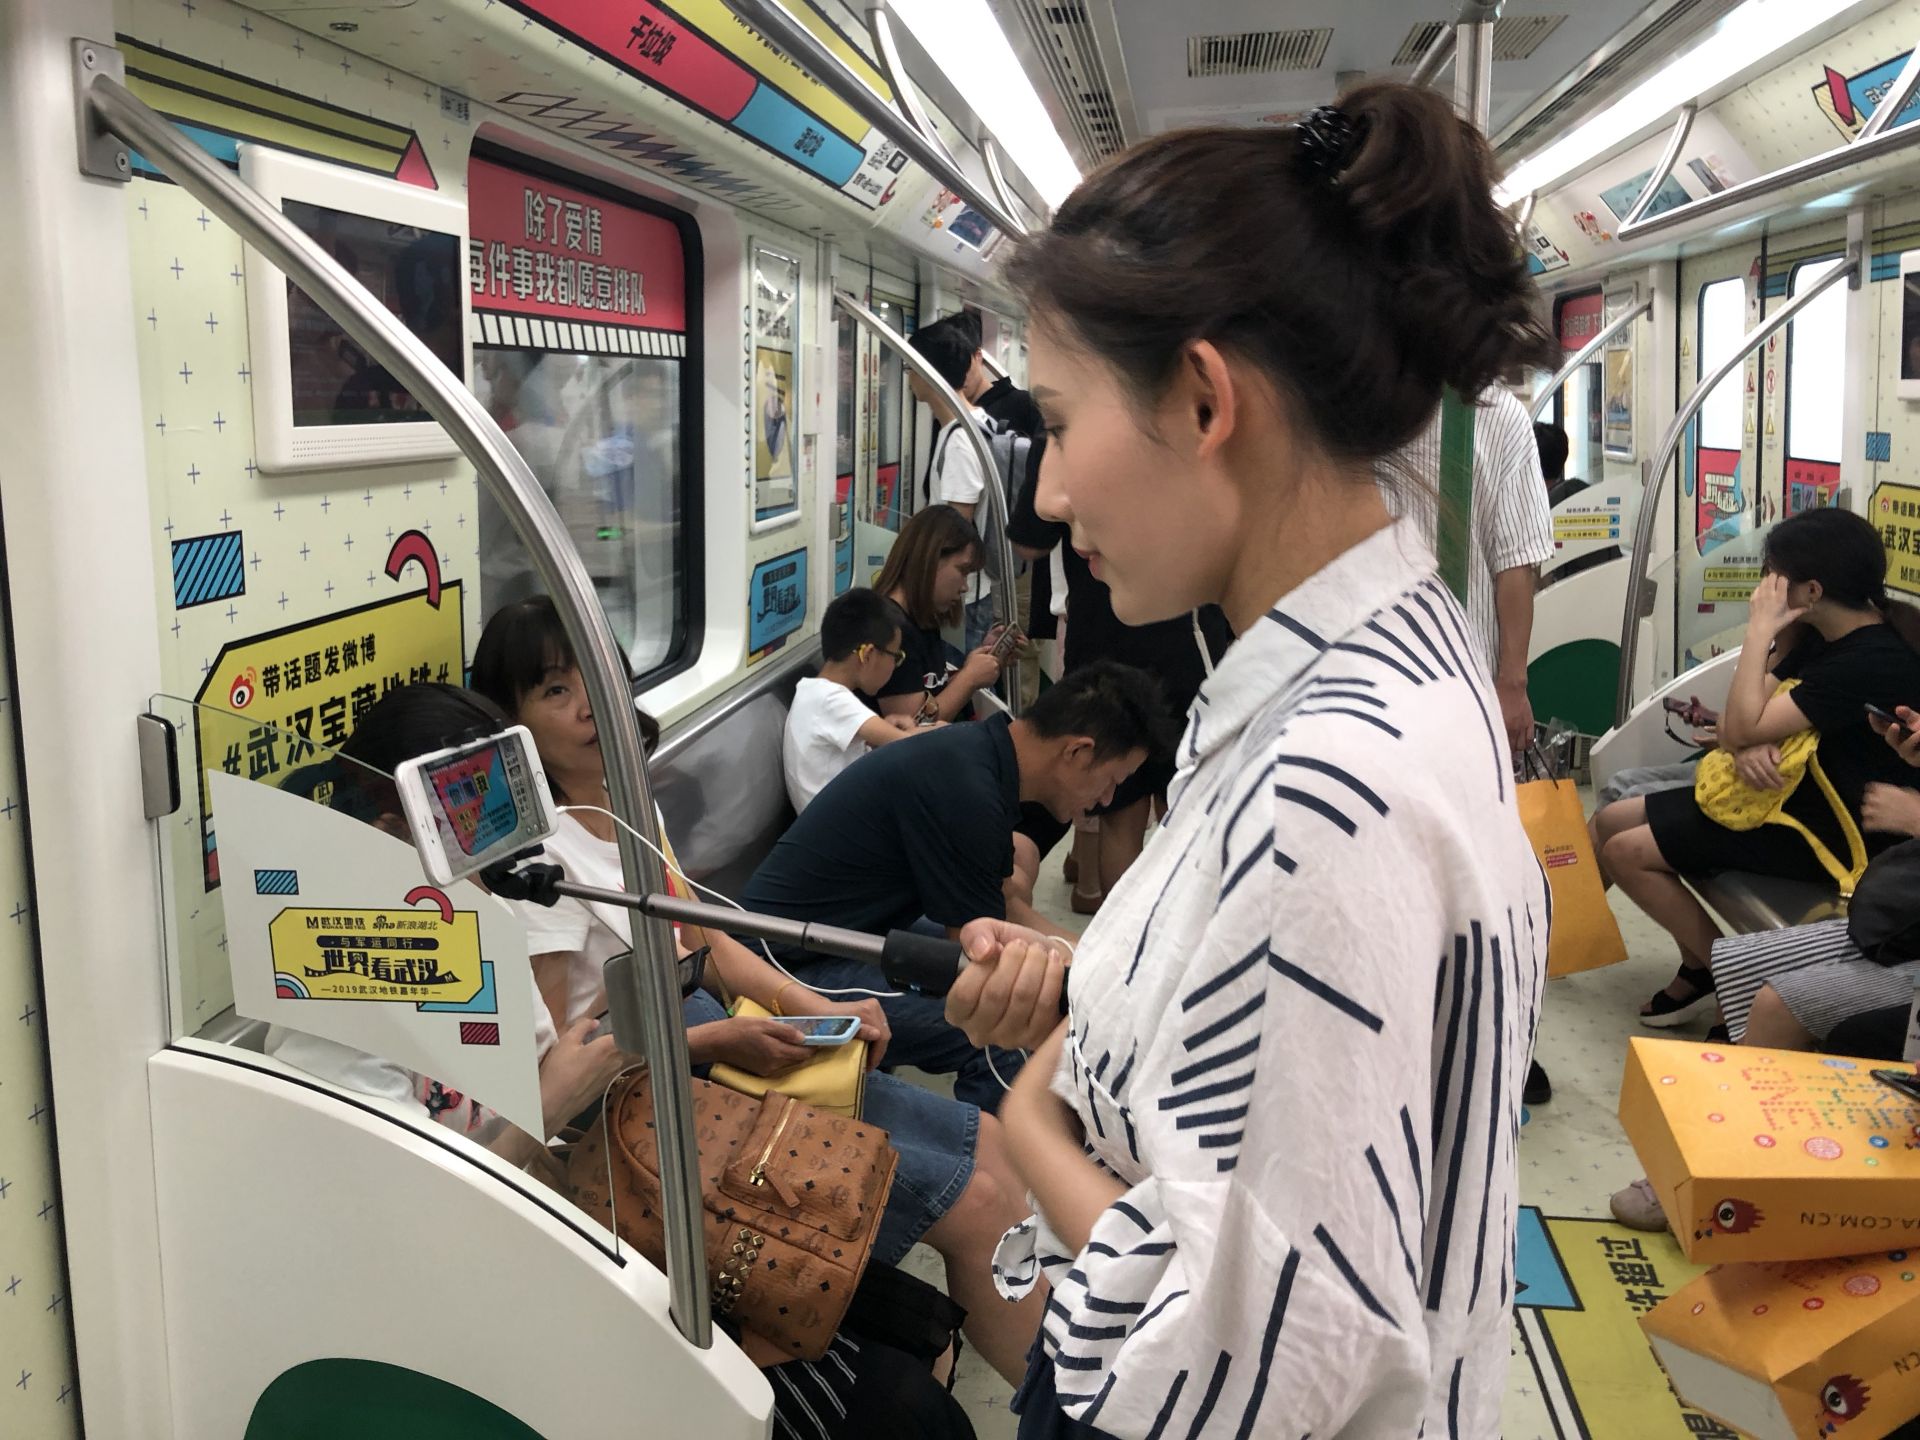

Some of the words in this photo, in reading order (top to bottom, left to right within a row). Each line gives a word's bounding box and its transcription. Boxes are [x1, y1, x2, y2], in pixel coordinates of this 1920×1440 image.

[626, 15, 677, 66] 干垃圾
[524, 189, 602, 256] 除了爱情
[470, 238, 647, 316] 每件事我都愿意排队
[262, 633, 376, 698] 带话题发微博
[320, 916, 365, 926] 武汉地铁
[396, 920, 438, 931] 新浪湖北
[321, 949, 440, 984] 世界看武汉
[1800, 1211, 1920, 1230] A.COM.CN
